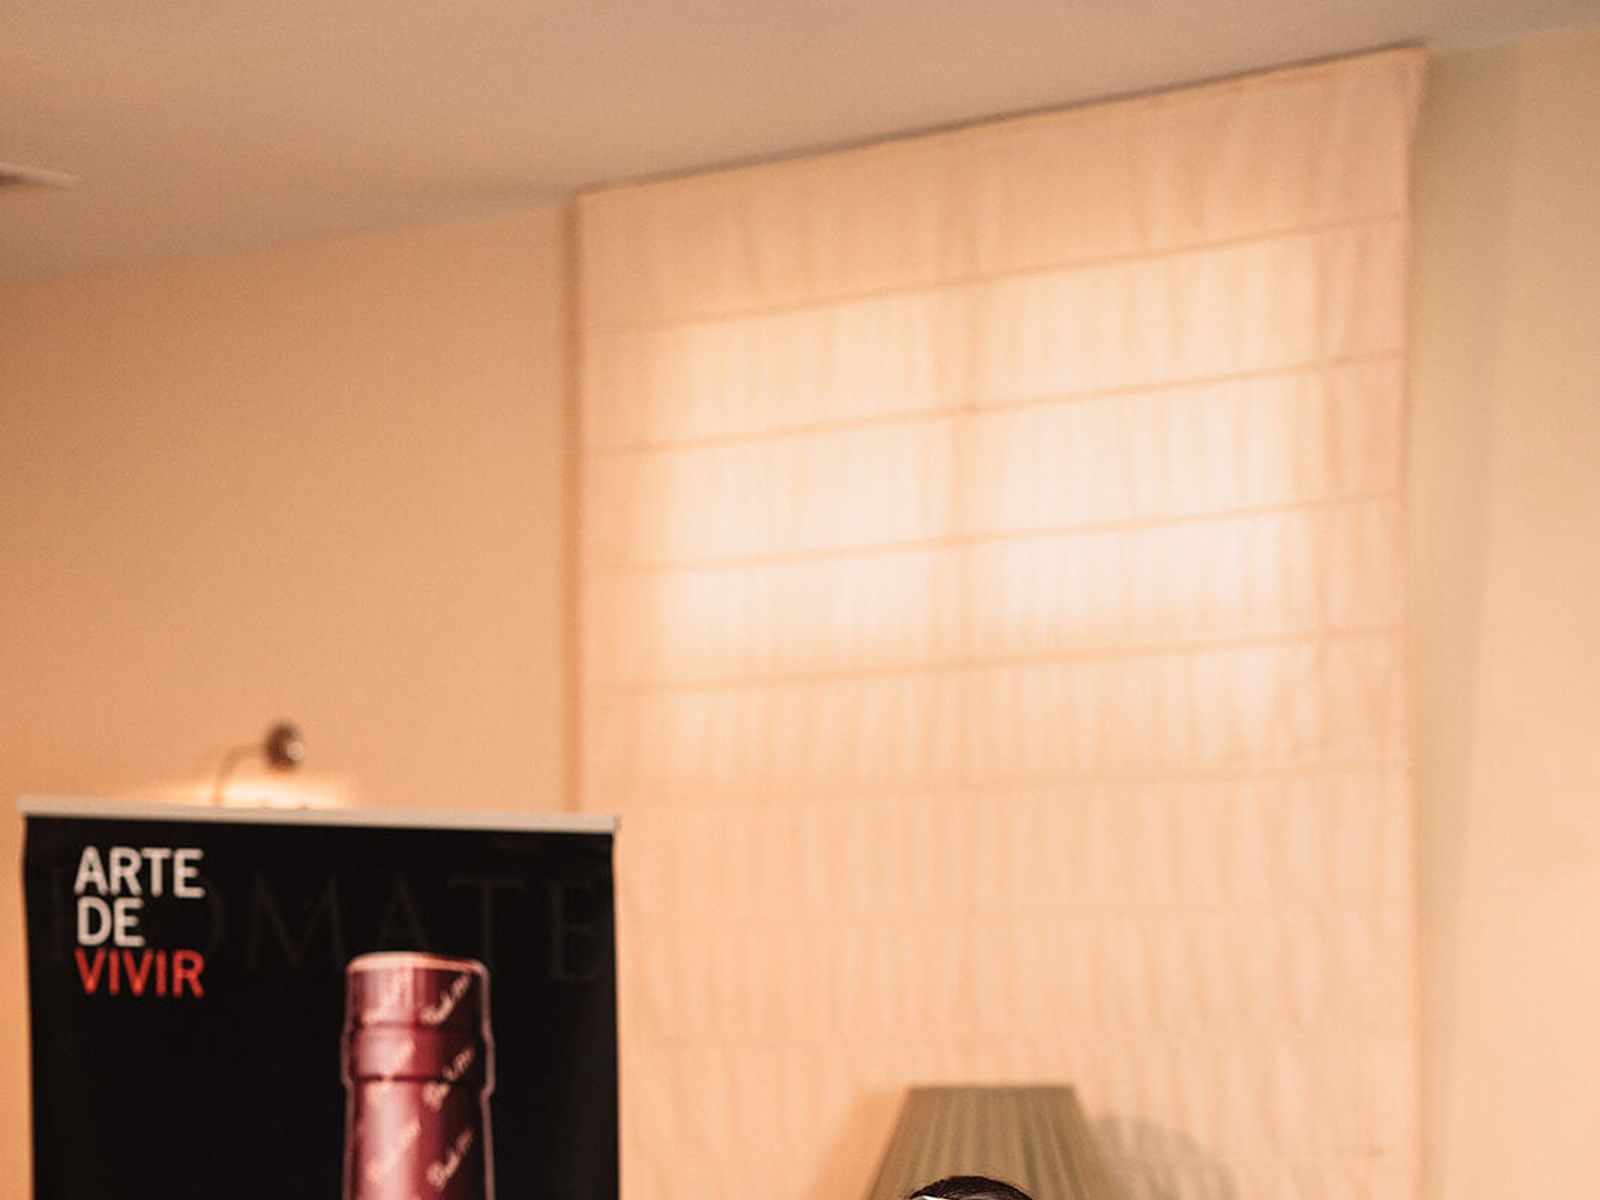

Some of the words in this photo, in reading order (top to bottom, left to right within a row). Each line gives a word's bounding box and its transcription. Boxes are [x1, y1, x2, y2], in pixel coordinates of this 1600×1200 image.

[74, 845, 207, 898] ARTE
[77, 895, 146, 948] DE
[74, 947, 206, 998] VIVIR
